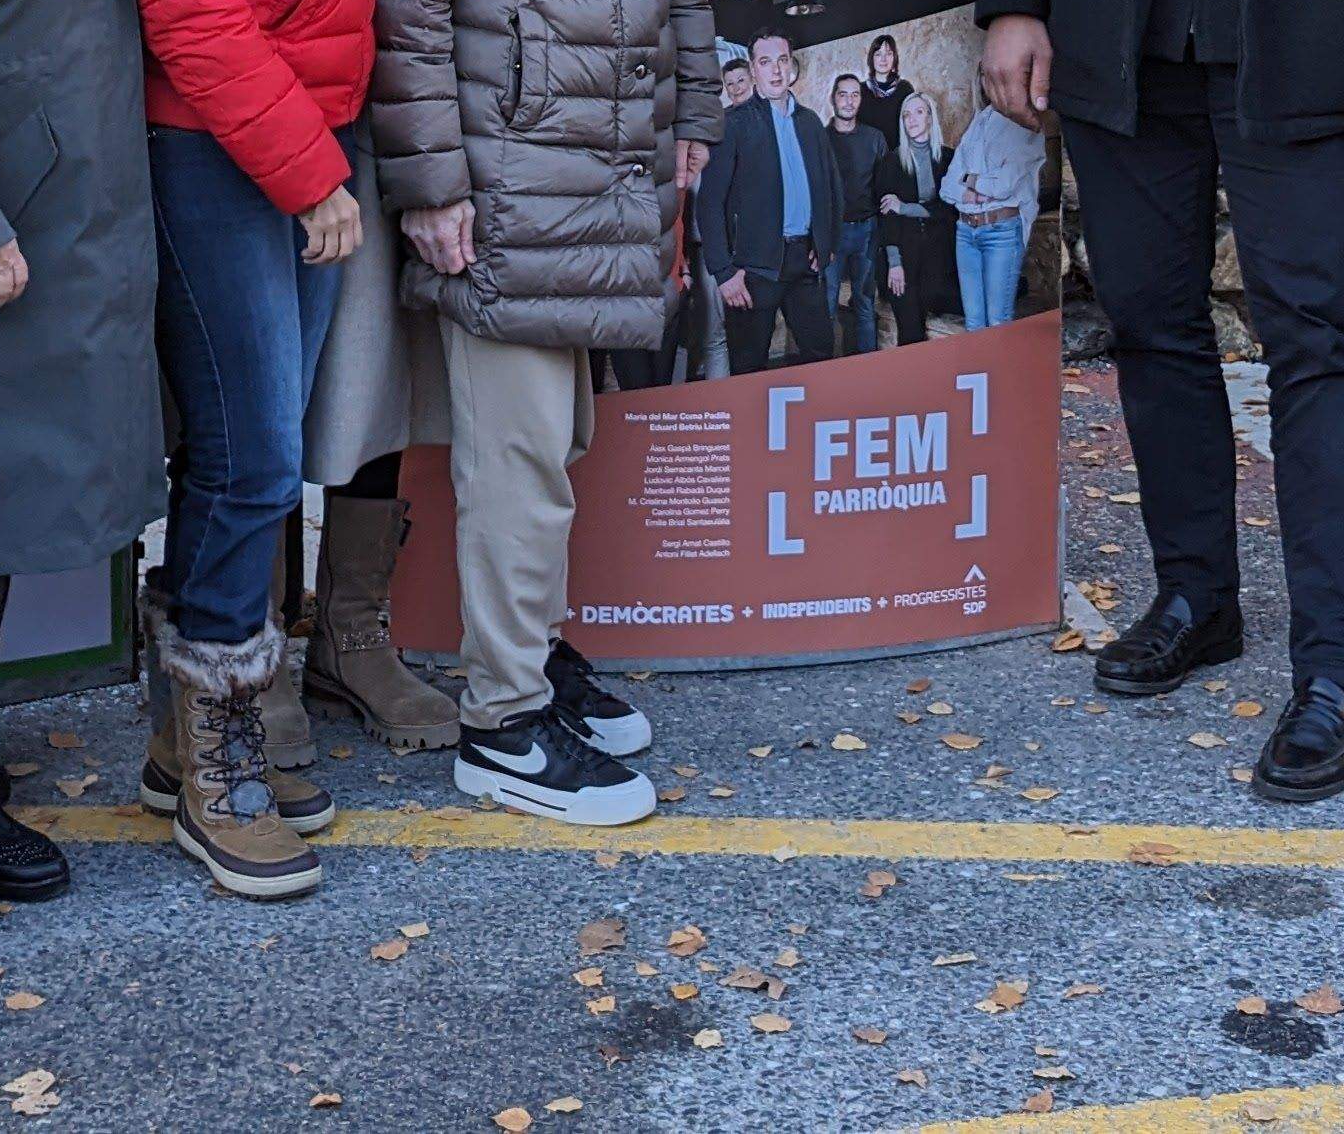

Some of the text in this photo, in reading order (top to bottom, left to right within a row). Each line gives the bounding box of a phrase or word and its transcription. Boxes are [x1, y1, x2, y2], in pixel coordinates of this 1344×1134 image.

[649, 423, 677, 431] Eduard
[815, 411, 949, 481] FEM
[814, 479, 946, 514] PARRÒQUIA
[582, 602, 735, 624] DEMÒCRATES
[762, 596, 872, 619] INDEPENDENTS
[894, 584, 986, 609] PROGRESSISTES
[963, 600, 986, 614] SDP
